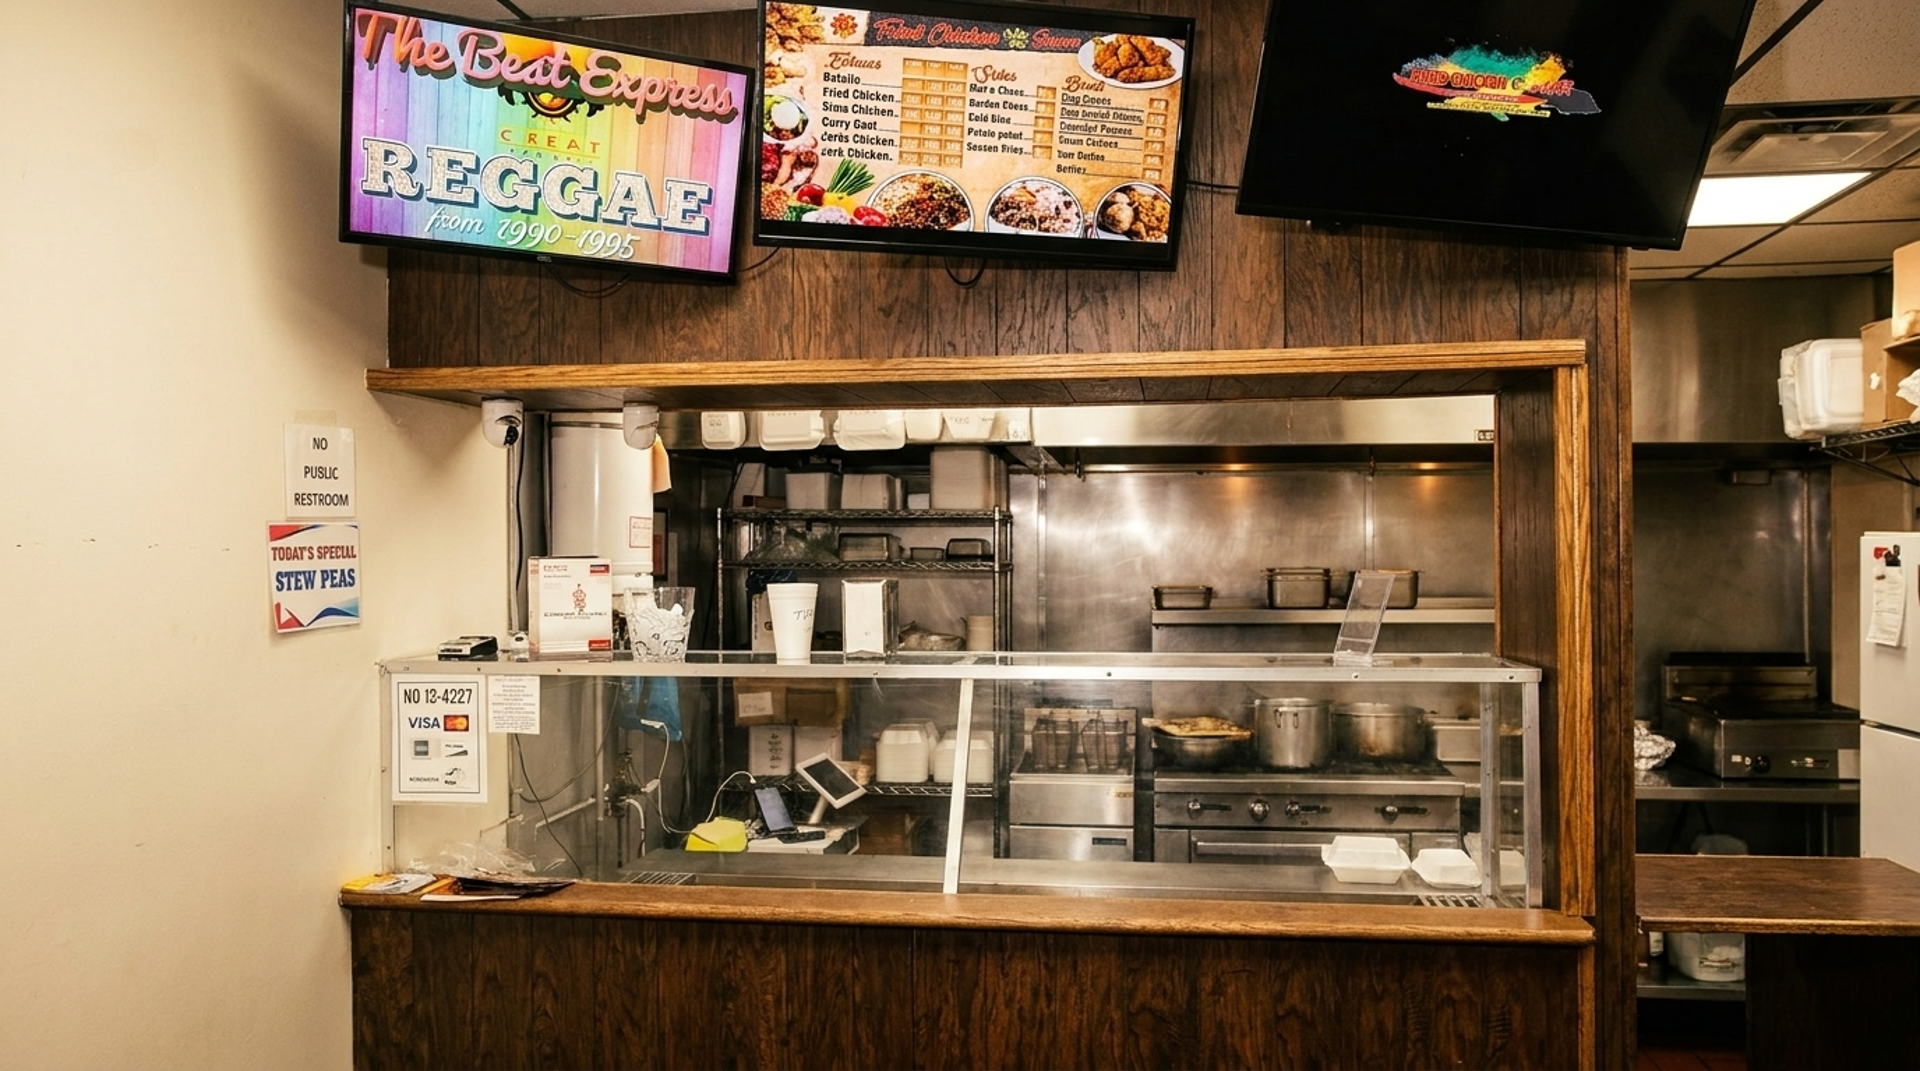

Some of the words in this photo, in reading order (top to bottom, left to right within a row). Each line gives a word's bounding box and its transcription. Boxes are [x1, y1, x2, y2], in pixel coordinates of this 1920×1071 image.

[357, 13, 455, 76] The
[457, 28, 571, 87] Best
[579, 50, 738, 122] Express
[823, 87, 849, 99] Fried
[822, 117, 850, 130] Curry
[361, 137, 713, 236] REGGAE
[425, 206, 485, 233] from
[312, 437, 328, 451] NO
[294, 492, 349, 507] RESTROOM
[276, 570, 317, 592] STEW
[320, 568, 355, 589] PEAS
[404, 688, 420, 704] NO
[408, 716, 441, 729] VISA
